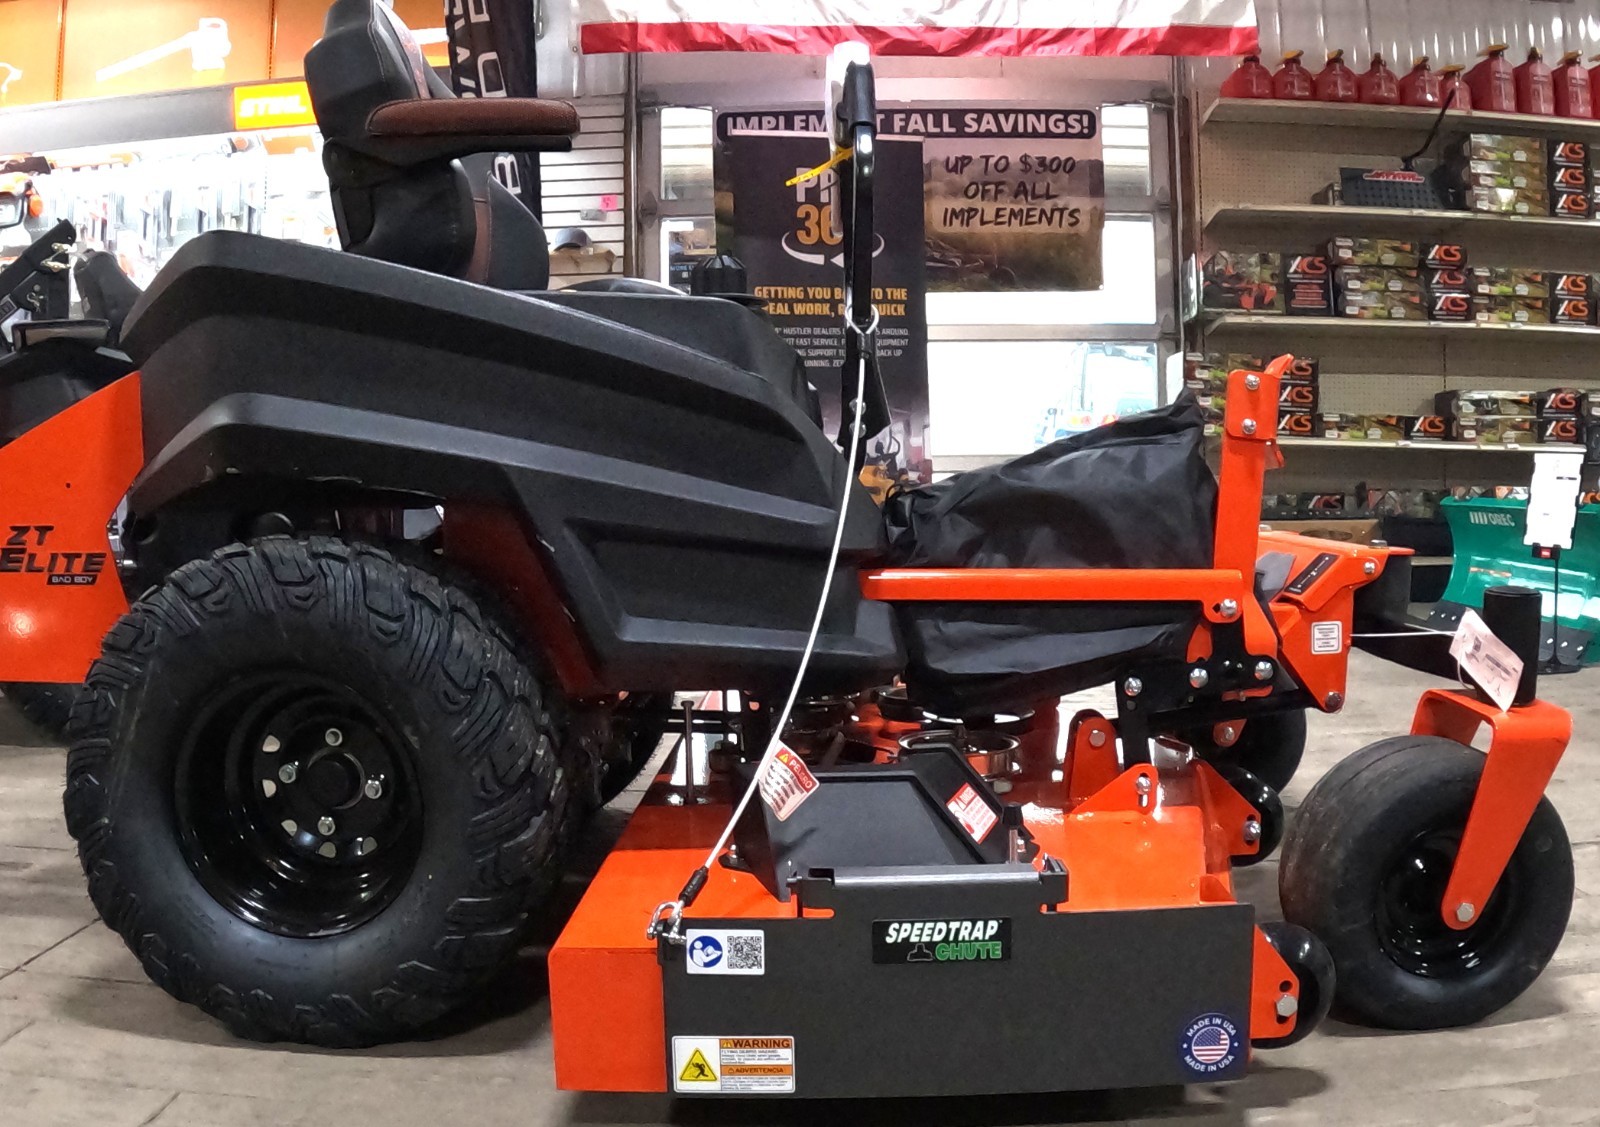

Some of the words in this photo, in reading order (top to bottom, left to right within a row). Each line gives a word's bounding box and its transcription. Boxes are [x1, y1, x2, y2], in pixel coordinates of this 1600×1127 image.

[894, 114, 957, 133] FALL
[964, 112, 1090, 135] SAVINGS!
[945, 155, 975, 173] UP
[983, 154, 1010, 173] TO
[1019, 152, 1076, 174] $300
[963, 181, 1003, 200] OFF
[1013, 180, 1058, 200] ALL
[942, 206, 1081, 228] IMPLEMENTS
[754, 286, 804, 299] GETTING
[807, 287, 831, 299] YOU
[886, 288, 908, 300] THE
[793, 303, 835, 318] WORK,
[783, 327, 812, 335] HUSTLER
[813, 327, 841, 335] DEALERS
[807, 349, 837, 357] SUPPORT
[893, 349, 903, 357] UP
[1488, 514, 1516, 527] OREC
[6, 525, 54, 546] ZT
[0, 547, 107, 573] ELITE
[885, 919, 999, 943] SPEEDTRAP
[935, 941, 1002, 961] CHUTE
[1186, 1017, 1210, 1037] MADE
[1212, 1017, 1222, 1025] IN
[1223, 1020, 1237, 1036] USA
[733, 1039, 790, 1048] WARNING
[1184, 1055, 1206, 1072] MADE
[1207, 1064, 1217, 1072] IN
[1218, 1055, 1235, 1069] USA
